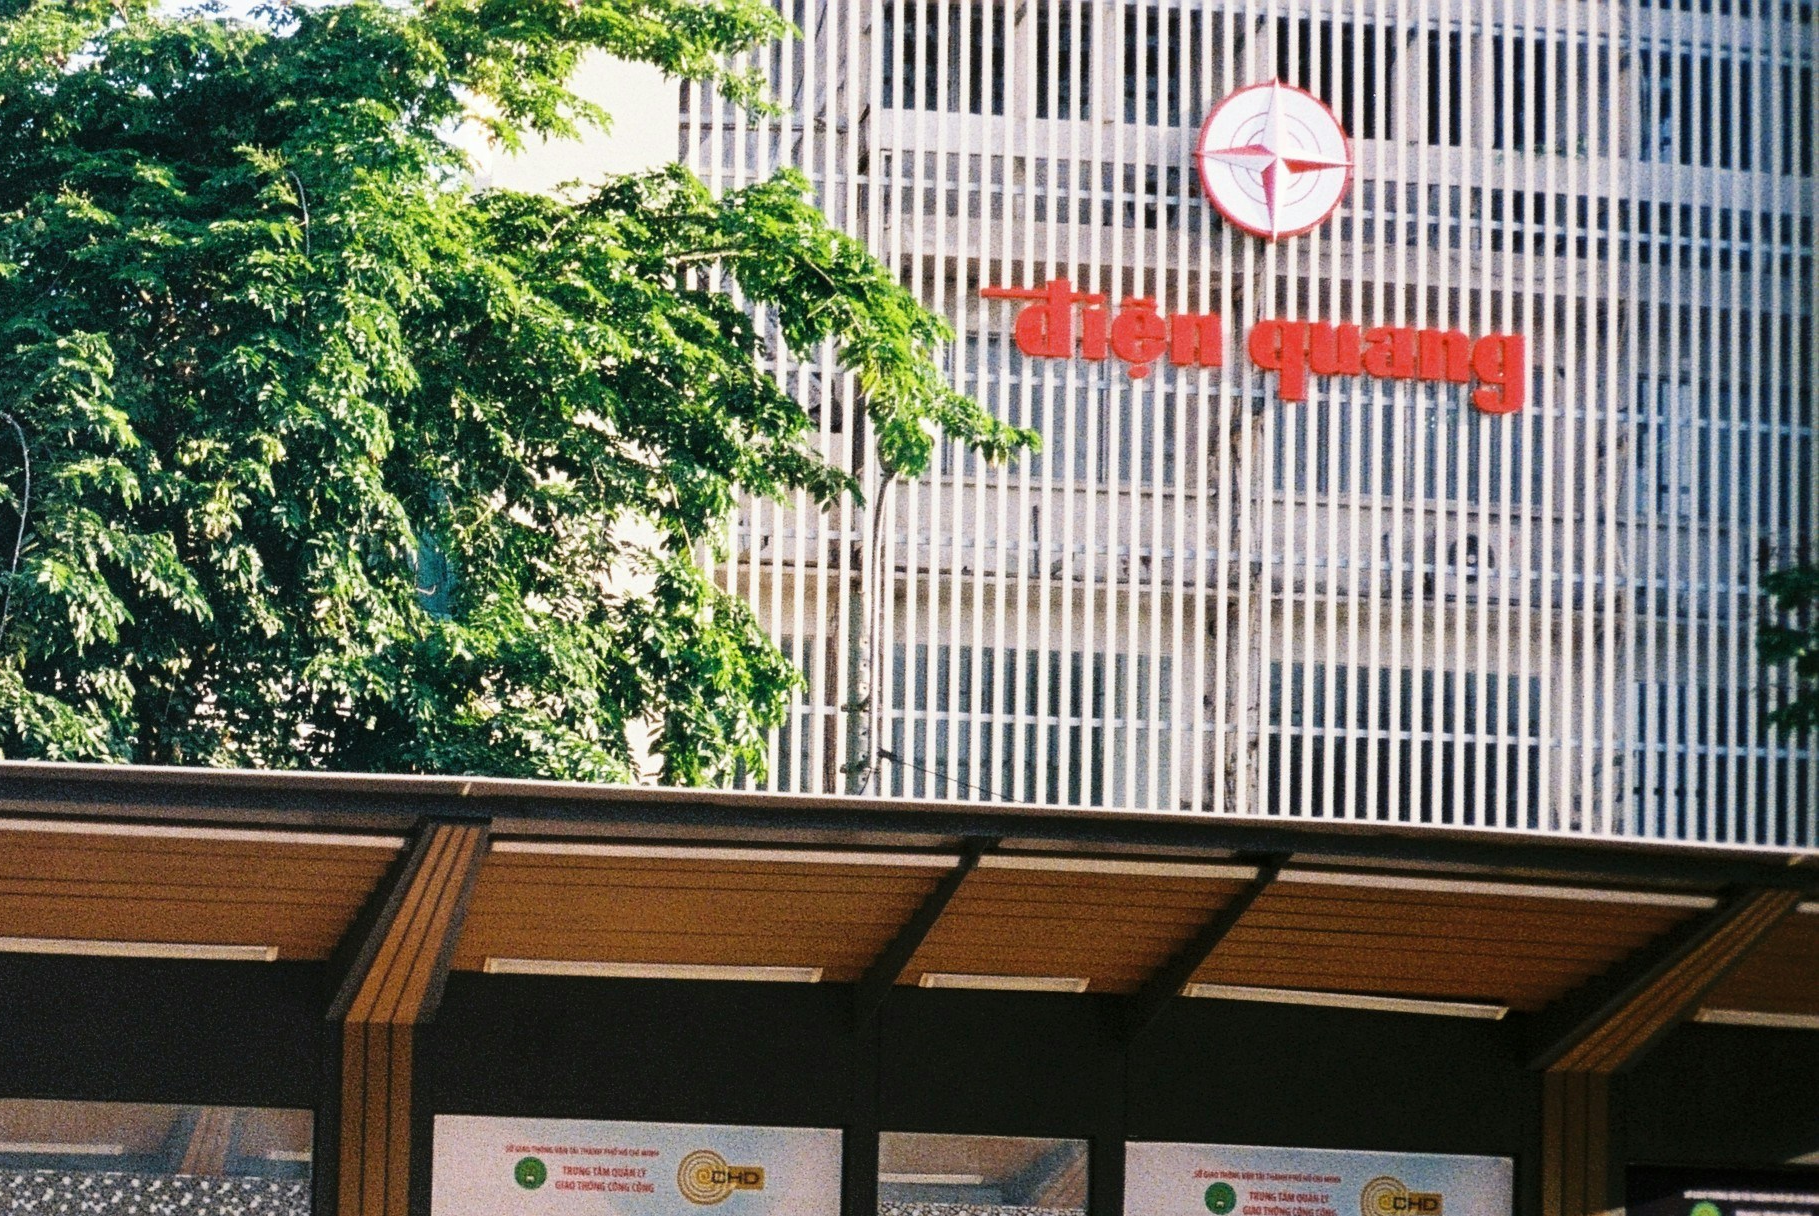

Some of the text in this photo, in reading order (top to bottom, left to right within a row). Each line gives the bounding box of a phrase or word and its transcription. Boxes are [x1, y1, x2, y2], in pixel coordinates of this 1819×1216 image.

[981, 278, 1526, 416] điện quang
[710, 1170, 761, 1186] CHD
[1392, 1196, 1439, 1212] CHD
